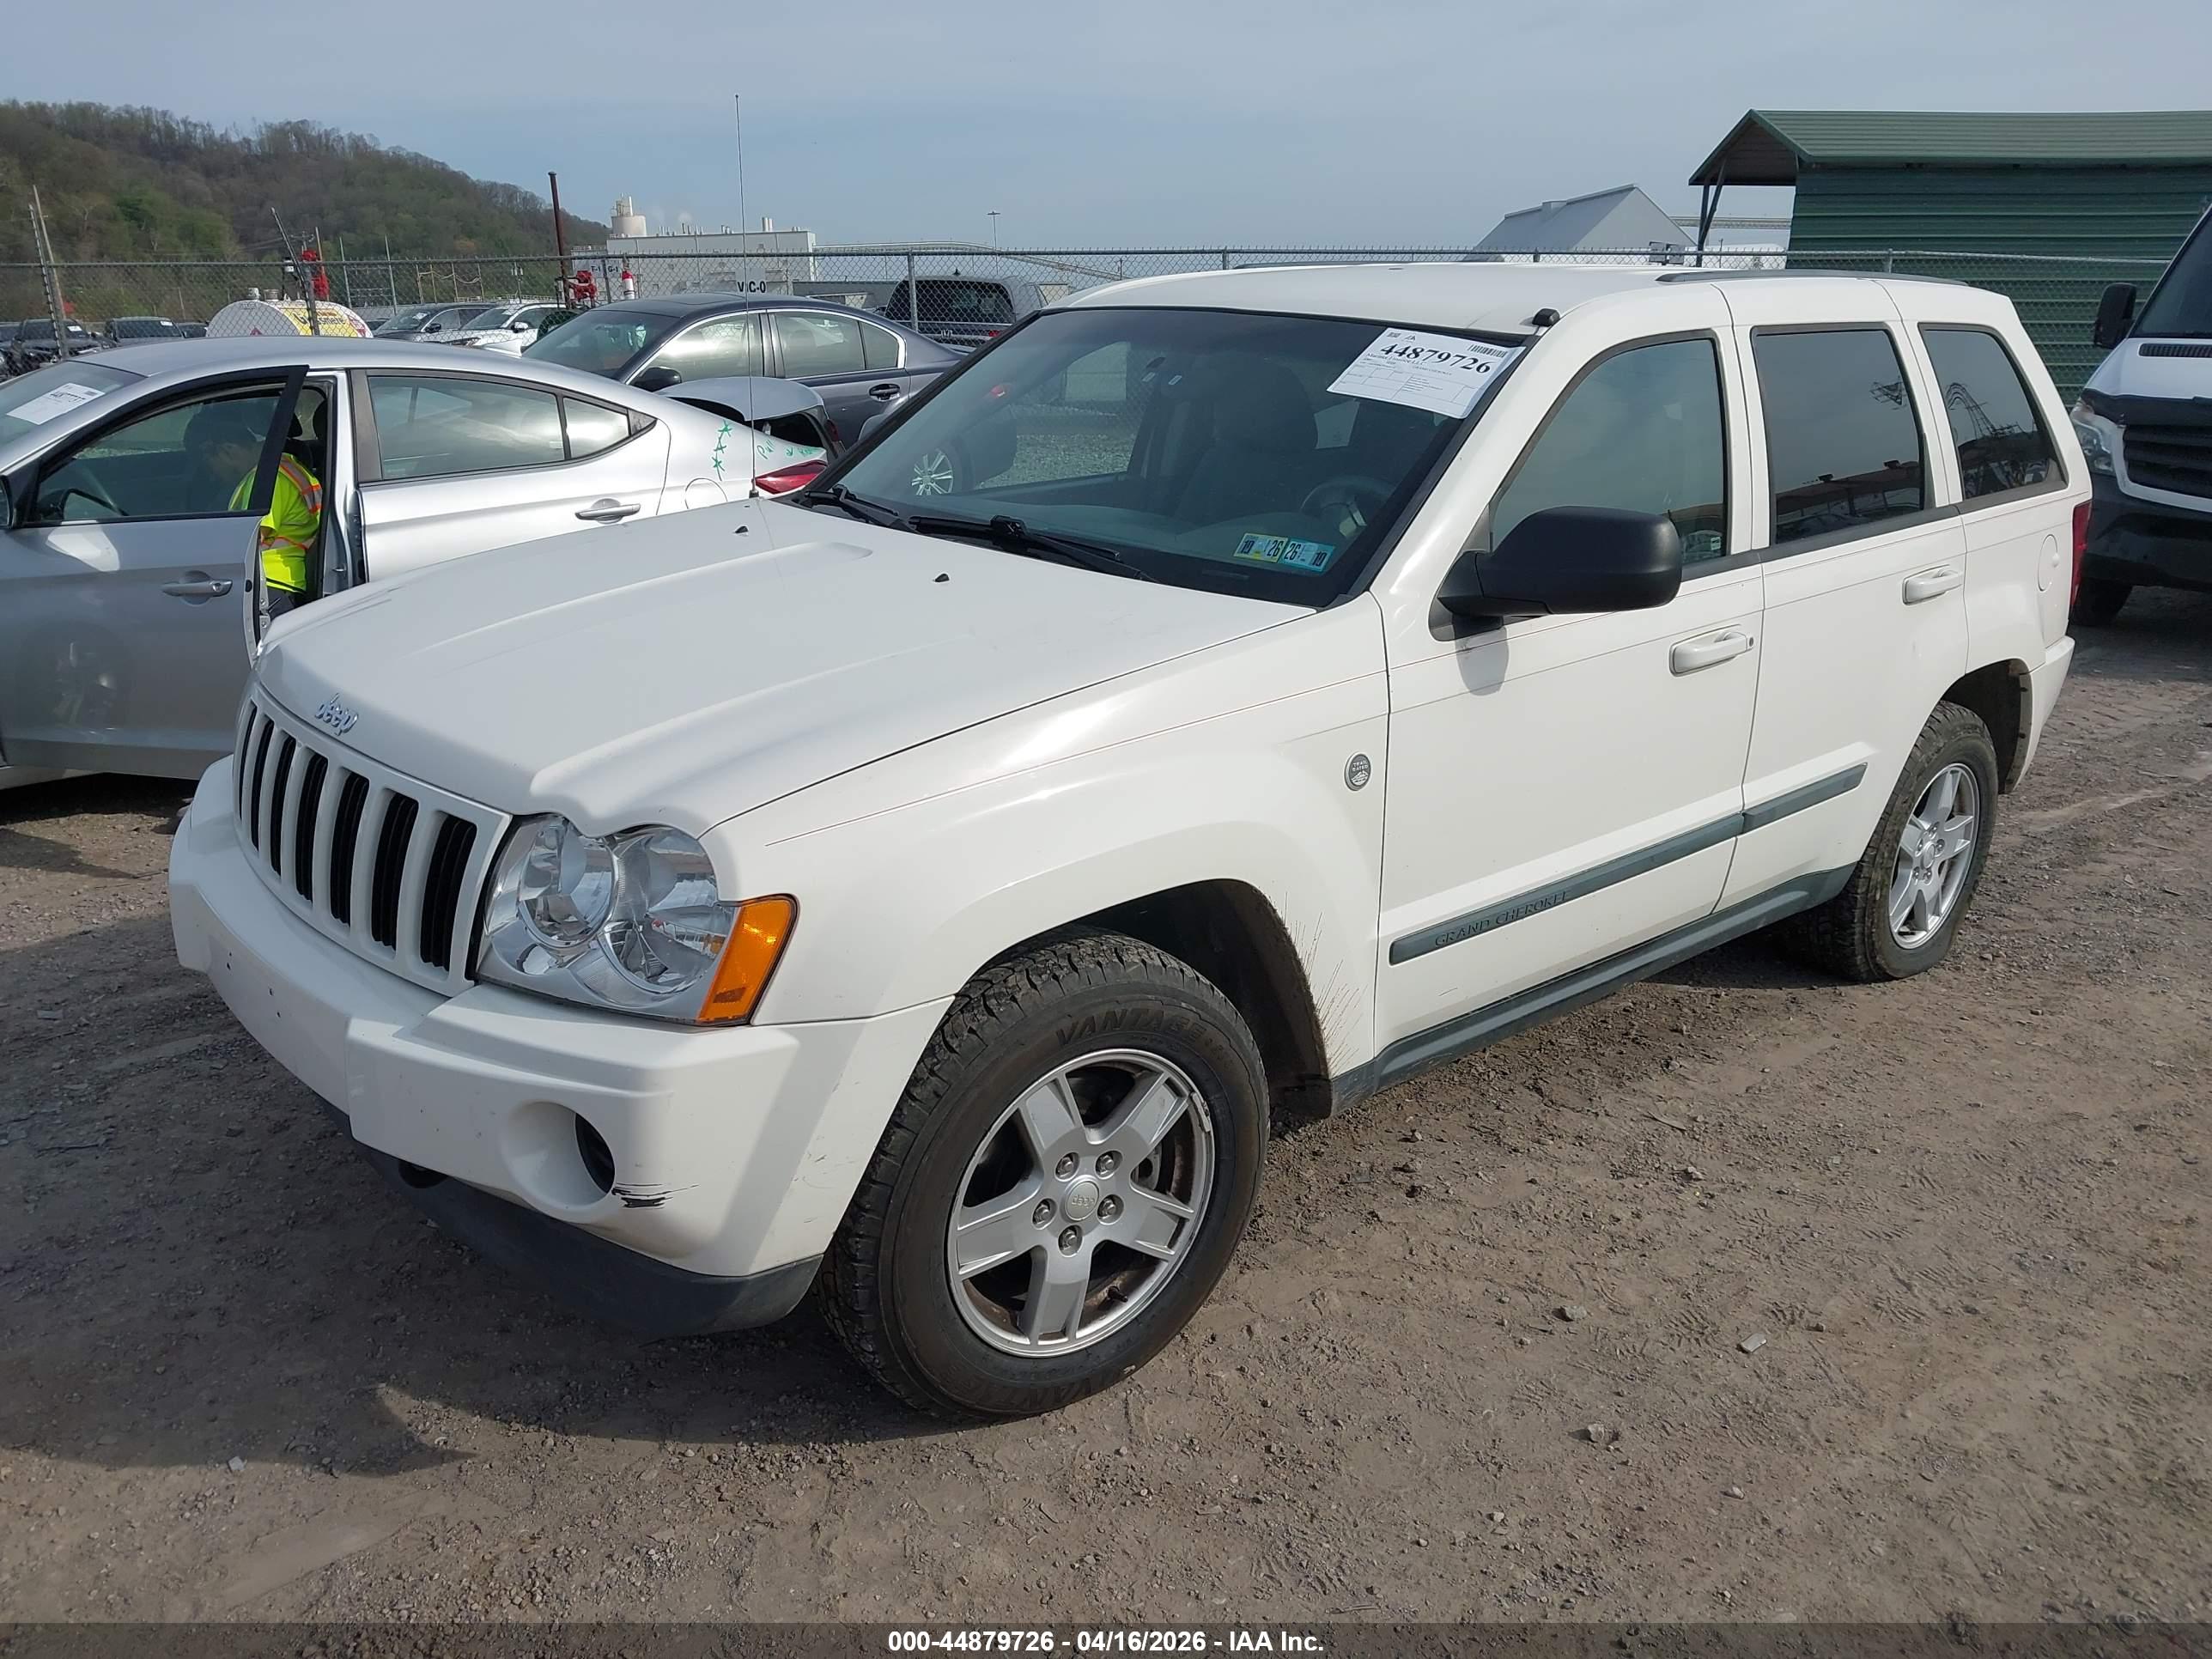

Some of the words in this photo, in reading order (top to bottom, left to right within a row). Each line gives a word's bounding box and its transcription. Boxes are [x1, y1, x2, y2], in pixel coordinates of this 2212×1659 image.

[1380, 343, 1492, 374] 44879726
[1267, 539, 1284, 556] 26
[1284, 542, 1302, 561] 26
[314, 692, 359, 737] Jeep
[1435, 919, 1490, 947] GRAND
[1495, 890, 1572, 925] CHEROKEE
